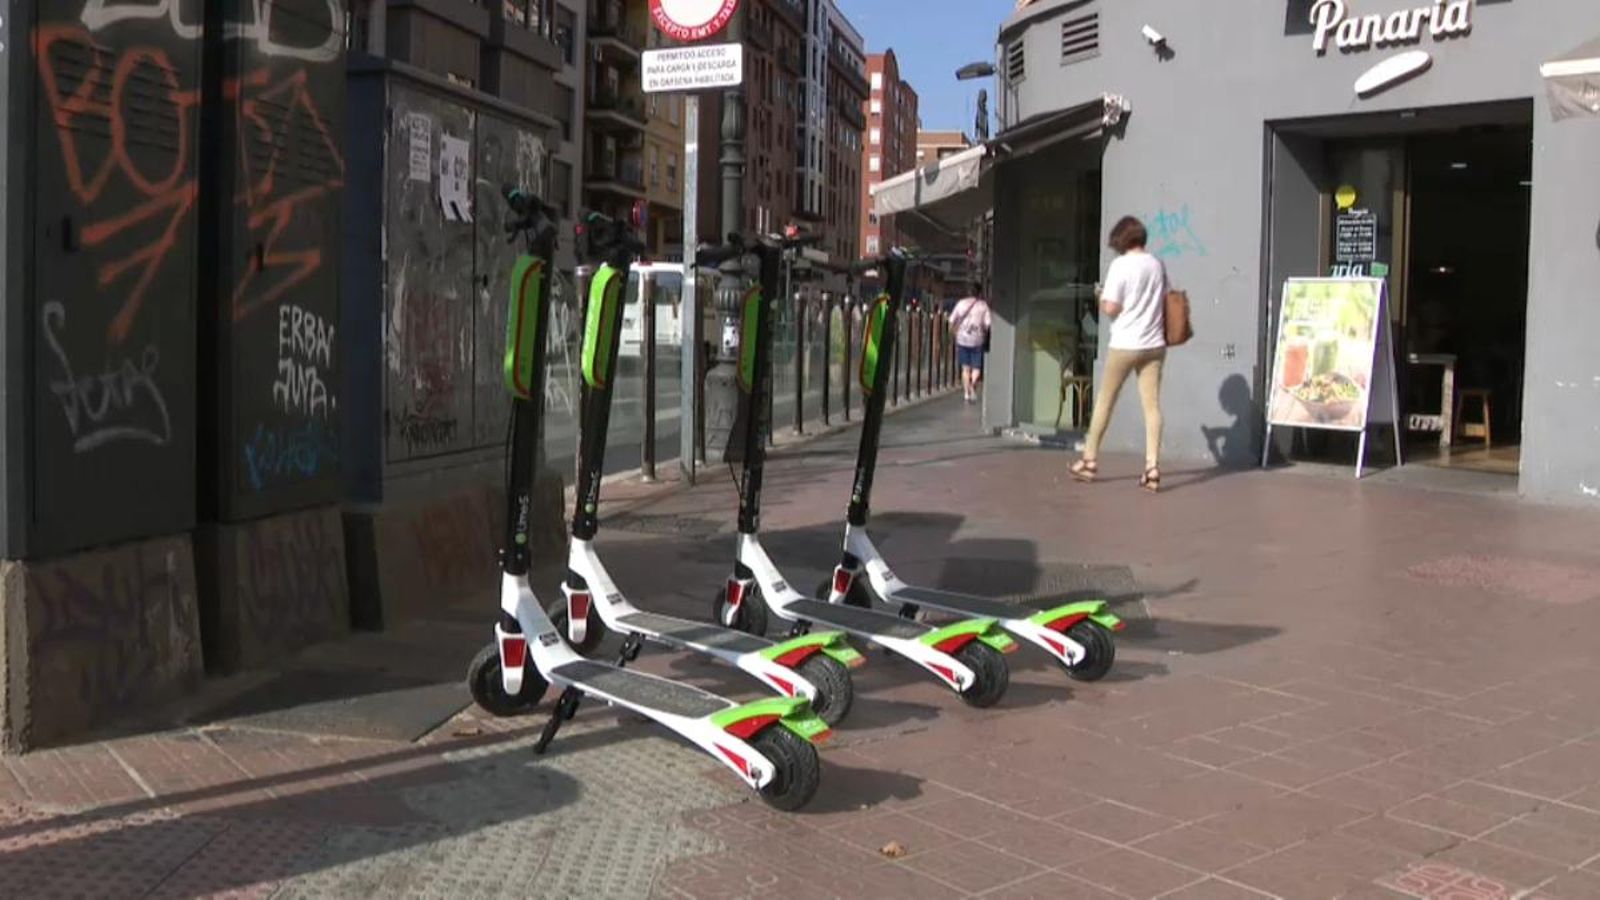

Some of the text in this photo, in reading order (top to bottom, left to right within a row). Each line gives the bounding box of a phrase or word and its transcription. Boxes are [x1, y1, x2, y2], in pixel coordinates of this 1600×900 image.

[1309, 0, 1470, 52] Panaria
[657, 47, 727, 62] PERMITIDO ACCESO
[647, 64, 666, 75] PARA
[666, 62, 690, 73] CARGA
[697, 59, 737, 71] DESCARGA
[649, 79, 659, 88] EN
[695, 73, 735, 84] HABILITADA
